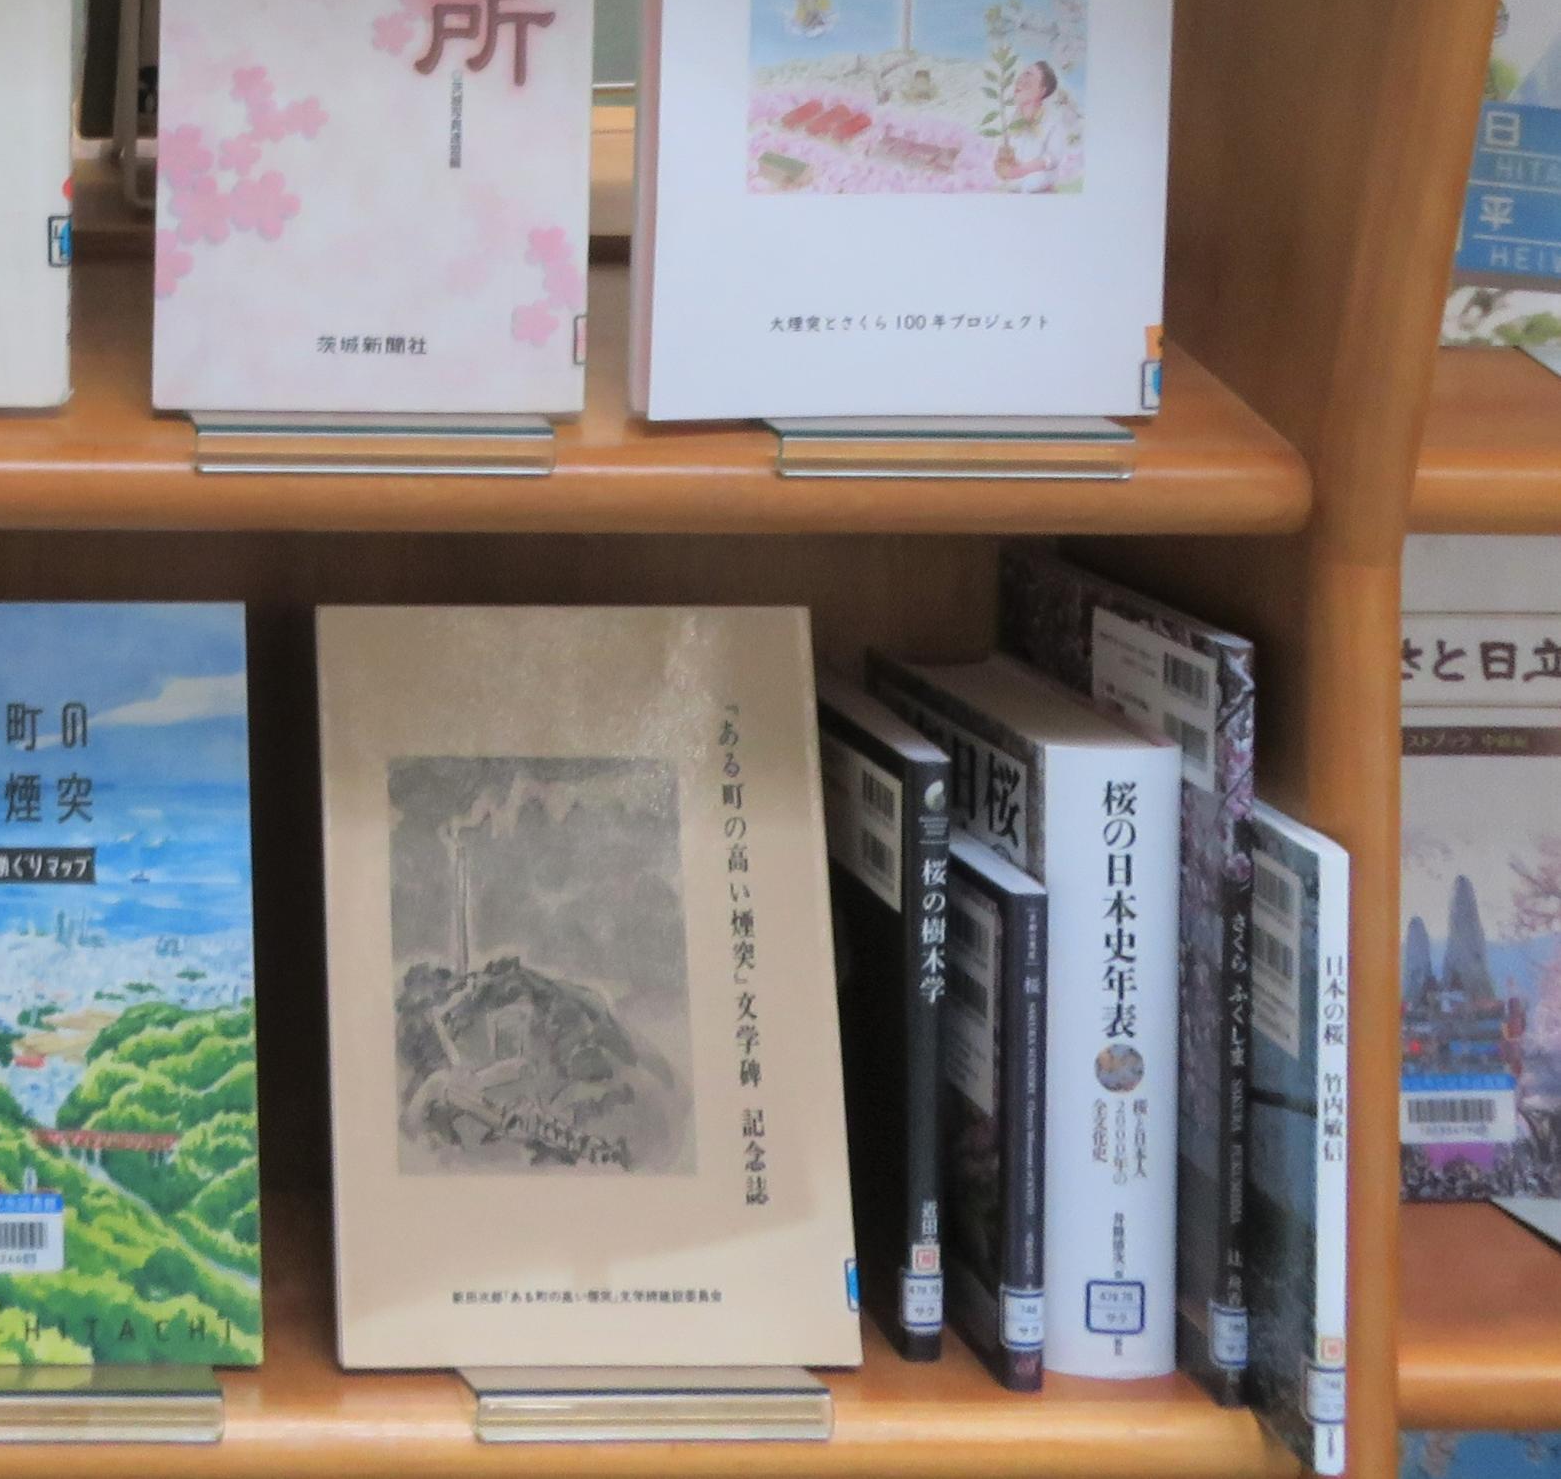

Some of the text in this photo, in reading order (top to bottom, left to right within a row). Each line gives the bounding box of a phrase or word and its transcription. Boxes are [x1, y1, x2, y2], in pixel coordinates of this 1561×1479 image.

[316, 335, 428, 356] 茨城新聞社
[918, 857, 950, 1005] 桜の樹木学
[1101, 779, 1139, 1040] 桜の日本史年表
[1322, 955, 1346, 1046] 日本の桜
